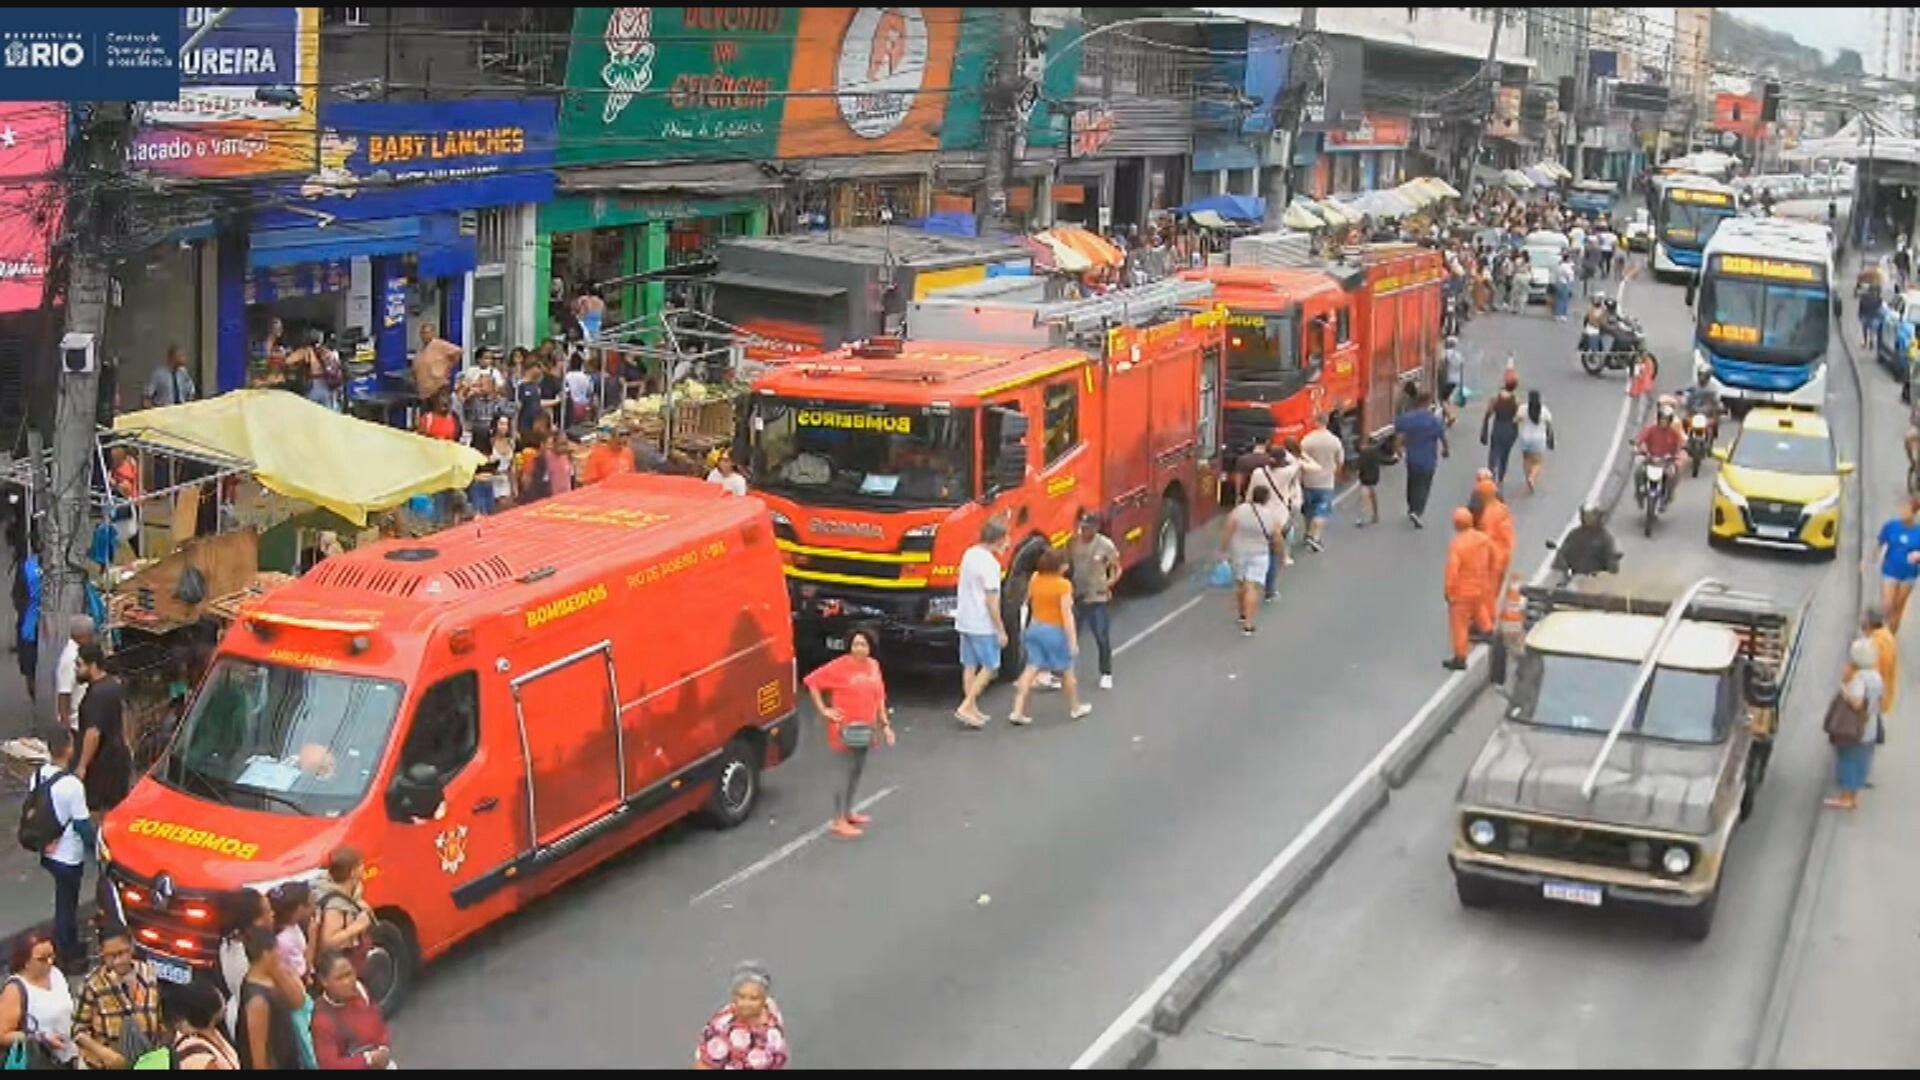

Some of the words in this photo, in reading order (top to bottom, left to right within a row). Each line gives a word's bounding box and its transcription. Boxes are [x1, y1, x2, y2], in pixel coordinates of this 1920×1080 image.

[179, 47, 277, 75] UREIRA
[368, 134, 427, 164] BABY
[432, 127, 525, 158] LANCHES
[808, 517, 885, 540] SCANIA
[526, 583, 608, 628] BOMBEIROS
